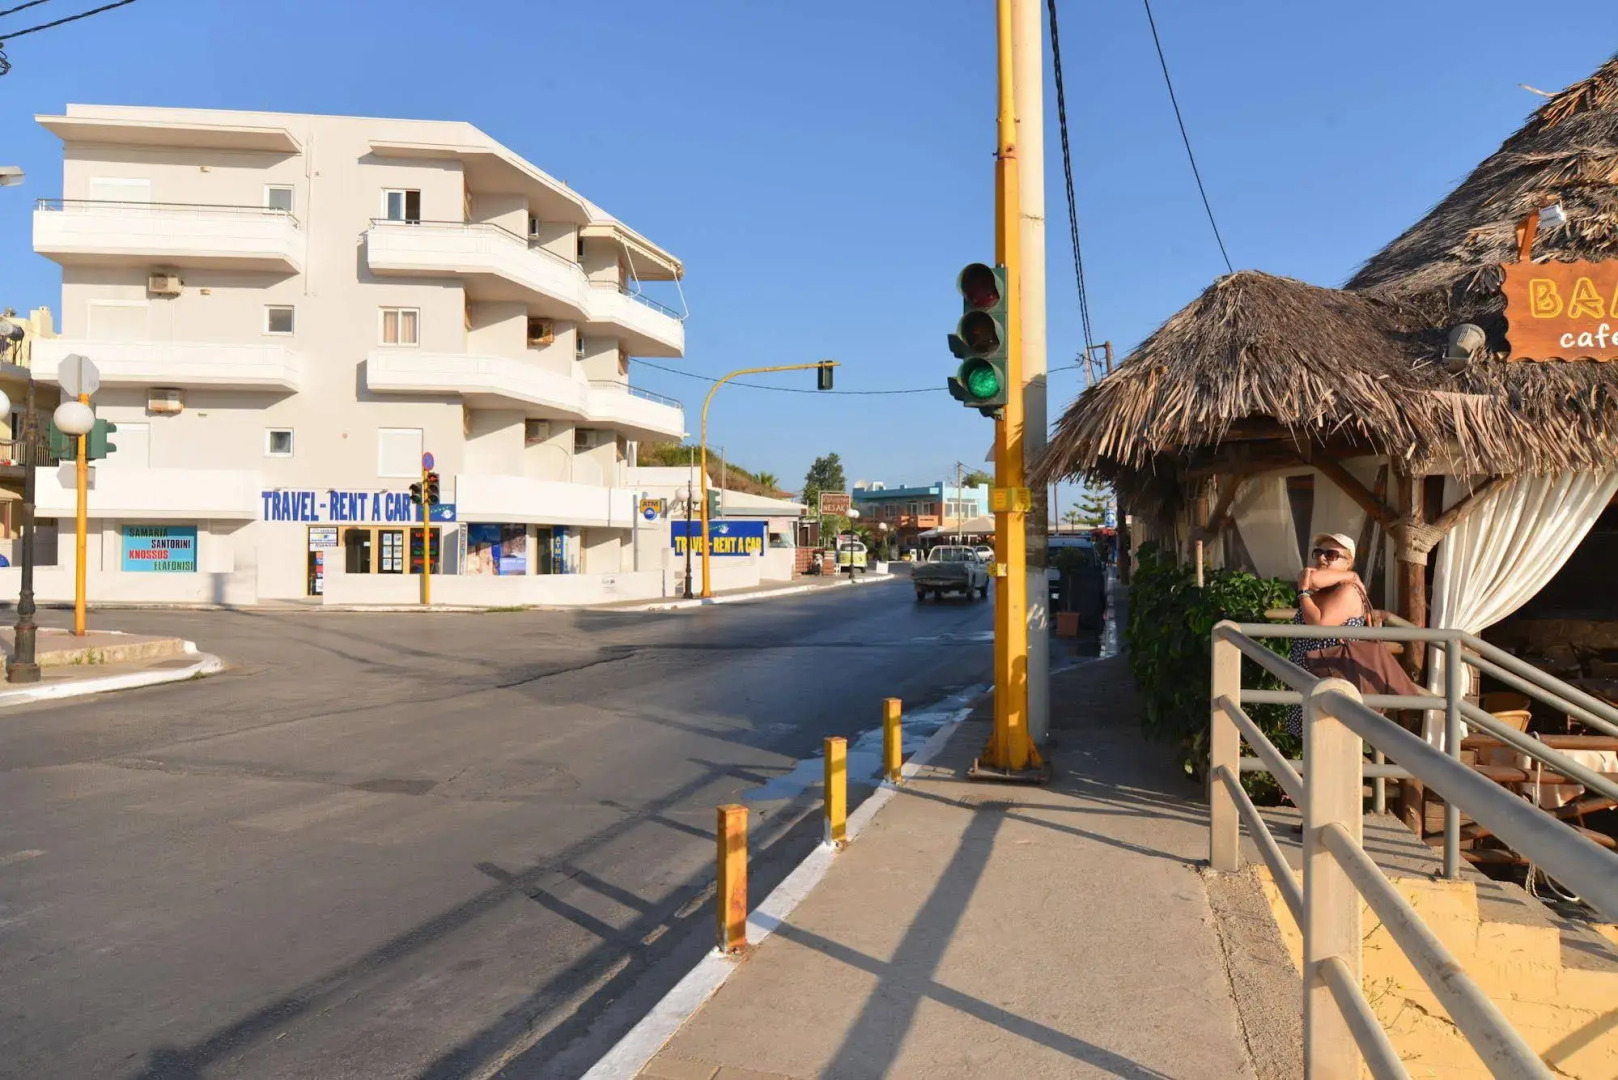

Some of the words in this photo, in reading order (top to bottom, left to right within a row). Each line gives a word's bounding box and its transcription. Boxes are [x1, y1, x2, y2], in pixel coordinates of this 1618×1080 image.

[1529, 277, 1618, 318] BA
[262, 491, 319, 521] TRAVEL
[330, 491, 368, 521] RENT
[371, 493, 381, 521] A
[385, 493, 411, 521] CAR
[129, 528, 168, 537] SAMARIA
[151, 539, 191, 549] SANTORINI
[713, 537, 736, 553] RENT
[738, 537, 744, 553] A
[745, 537, 762, 553] CAR
[129, 550, 168, 559] KNOSSOS
[154, 561, 193, 571] ELAFONISI
